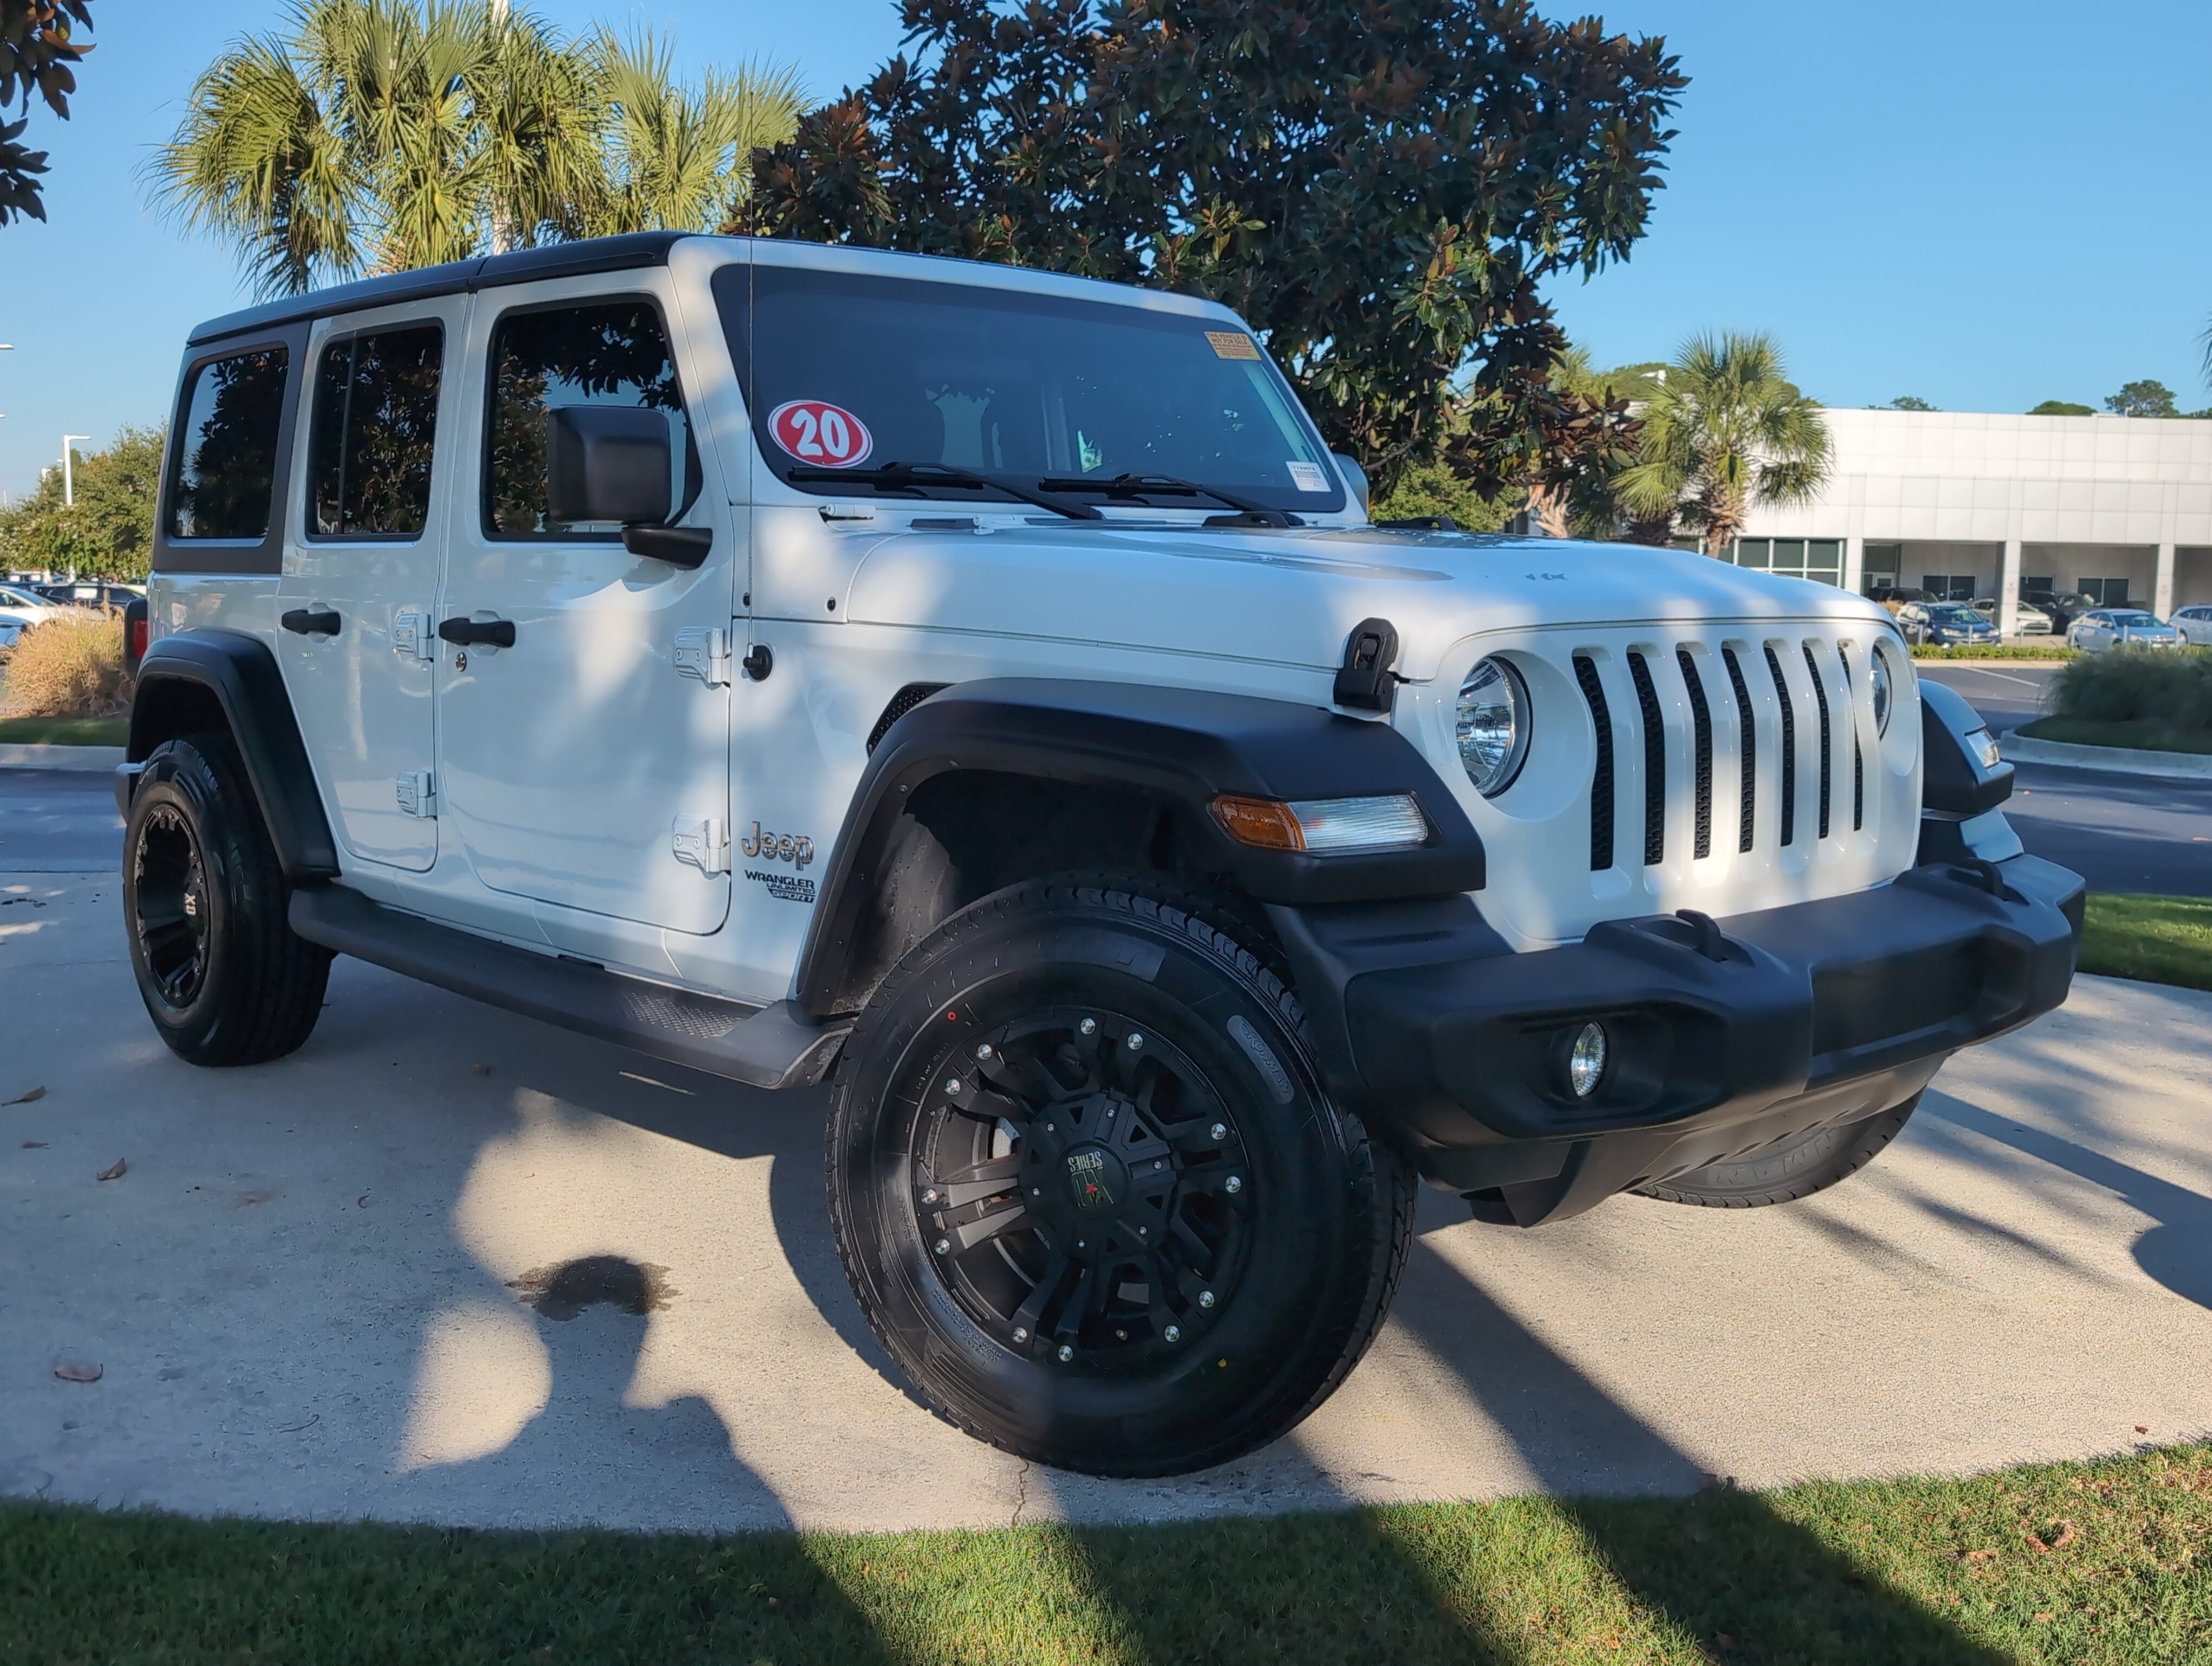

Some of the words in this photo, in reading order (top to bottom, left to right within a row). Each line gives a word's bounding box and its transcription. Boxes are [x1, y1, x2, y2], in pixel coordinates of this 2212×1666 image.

[790, 408, 850, 458] 20
[741, 821, 814, 871] Jeep
[744, 869, 815, 889] WRANGLER
[766, 883, 815, 894] UNLIMITED
[771, 890, 814, 902] SPORT
[1068, 1151, 1103, 1173] SERIES
